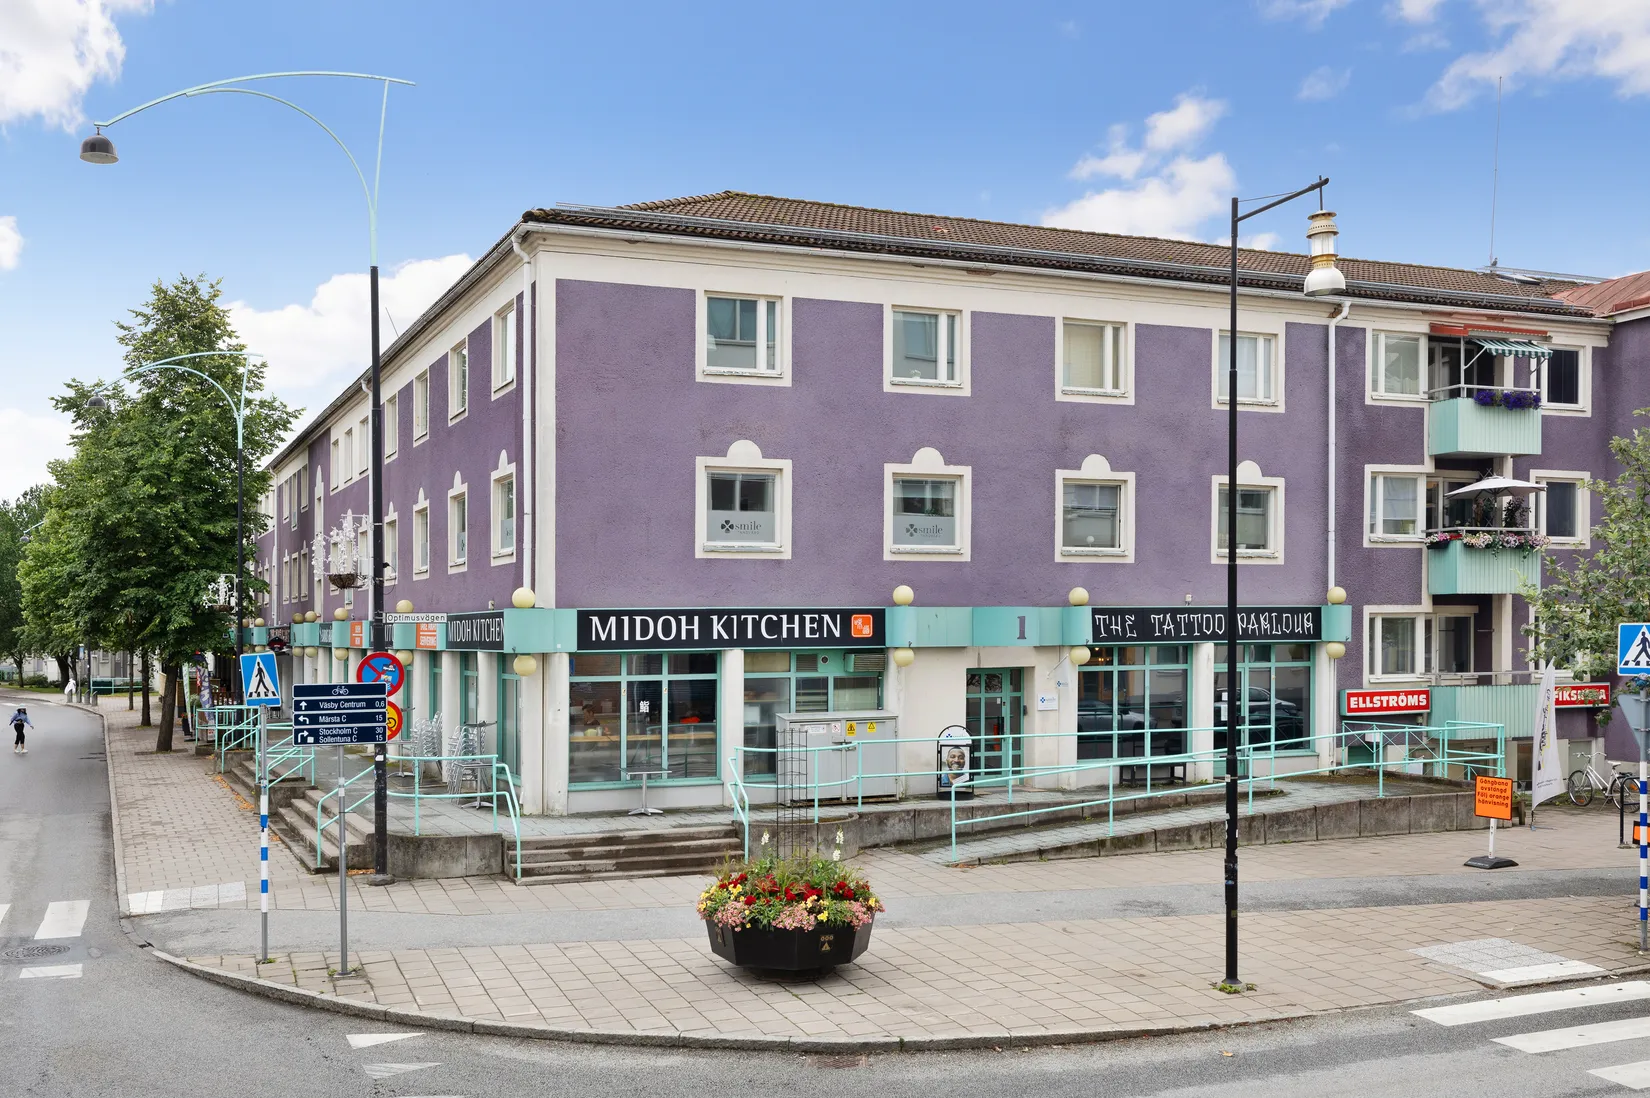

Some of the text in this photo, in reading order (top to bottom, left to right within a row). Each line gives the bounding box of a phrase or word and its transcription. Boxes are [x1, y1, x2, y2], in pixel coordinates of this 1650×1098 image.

[735, 521, 762, 531] smile
[918, 524, 943, 534] smile
[388, 614, 445, 622] Optimusvägen
[589, 615, 699, 641] MIDOH
[709, 614, 841, 640] KITCHEN
[1095, 612, 1314, 638] THE TATTOO PARLOUR
[448, 620, 472, 642] MIDOH
[319, 701, 338, 710] Väsby
[375, 700, 385, 708] 0,6
[1350, 692, 1427, 709] ELLSTRÖMS
[319, 714, 383, 723] Märsta C 15
[319, 727, 352, 736] Stockholm
[352, 727, 358, 735] C
[319, 735, 351, 744] Sollentuna
[375, 734, 383, 742] 15
[1480, 778, 1508, 786] Gångbana
[1489, 793, 1510, 801] orange
